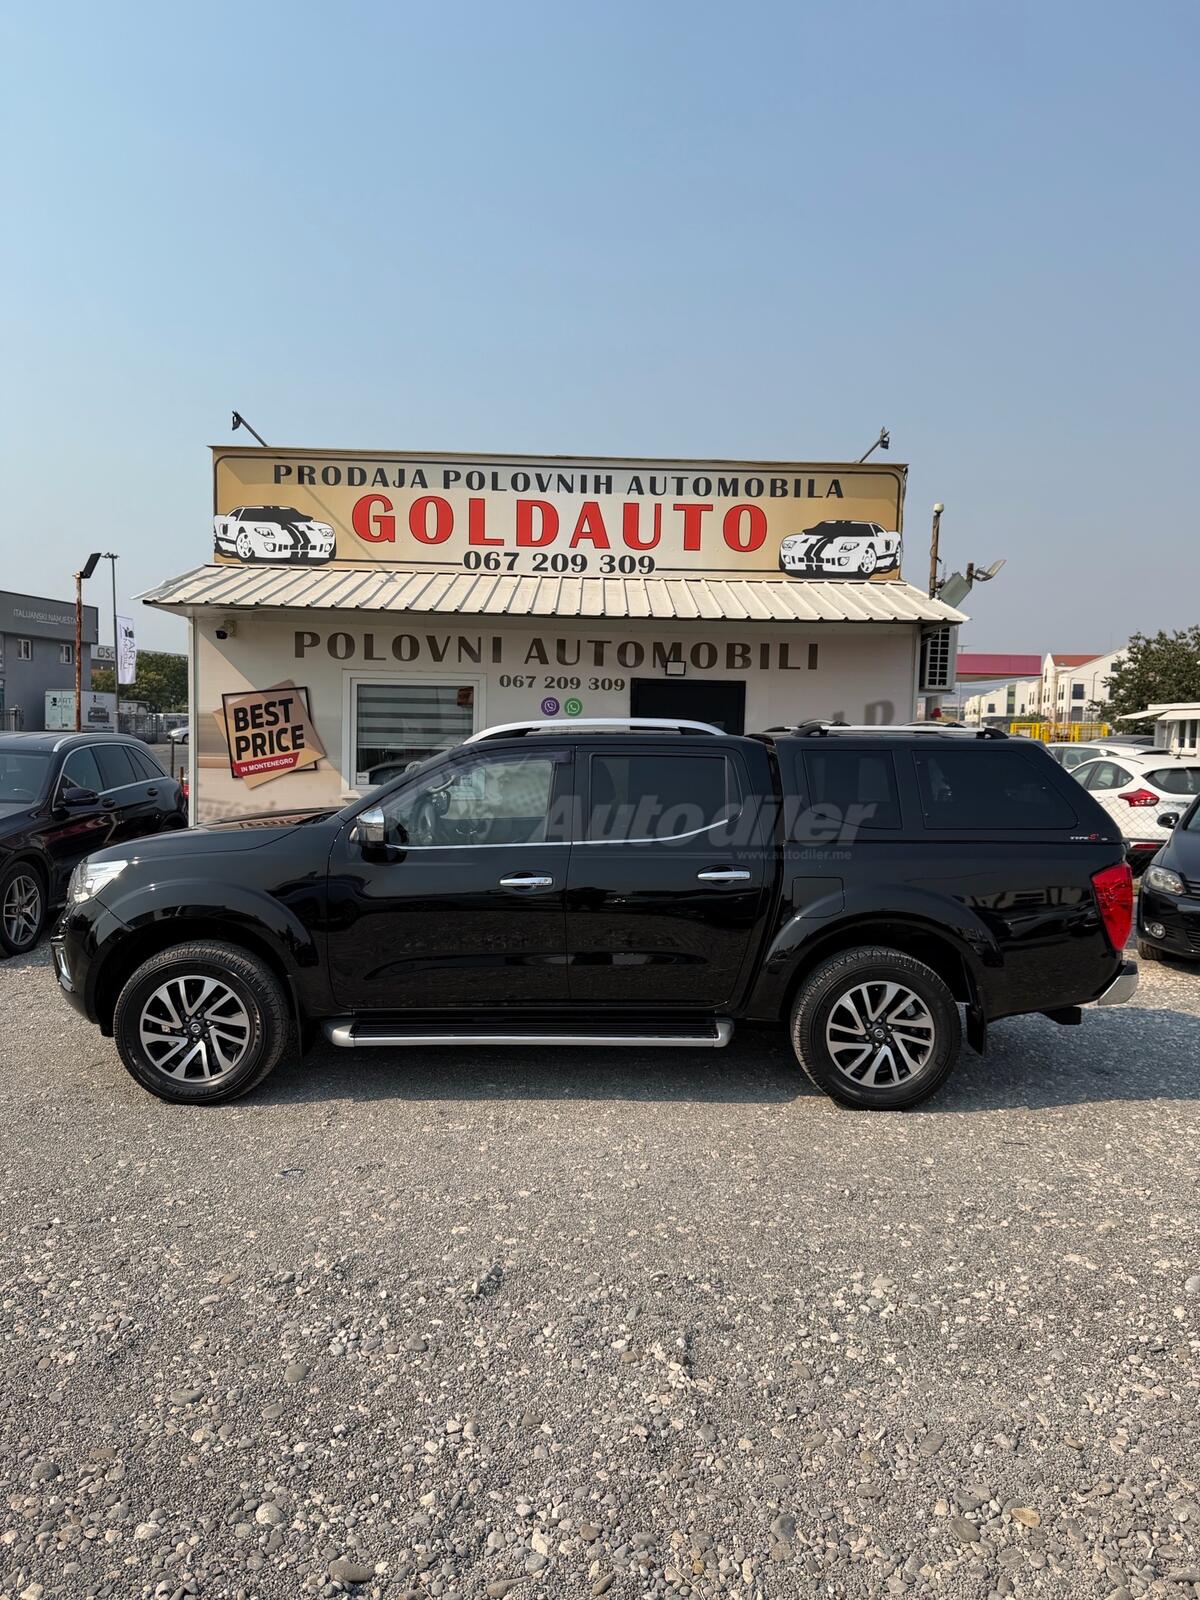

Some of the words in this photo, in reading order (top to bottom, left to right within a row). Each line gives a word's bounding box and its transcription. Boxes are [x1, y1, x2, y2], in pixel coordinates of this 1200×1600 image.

[273, 464, 428, 488] PRODAJA
[442, 470, 613, 494] POLOVNIH
[626, 474, 844, 499] AUTOMOBILA
[351, 493, 768, 553] GOLDAUTO
[463, 550, 520, 572] 067
[532, 552, 588, 574] 209
[599, 554, 656, 575] 309
[294, 631, 502, 664] POLOVNI
[524, 638, 818, 669] AUTOMOBILI
[499, 674, 536, 688] 067
[544, 676, 581, 690] 209
[588, 678, 626, 691] 309
[233, 698, 294, 733] BEST
[235, 724, 305, 761] PRICE
[248, 757, 294, 772] MONTENEGRO
